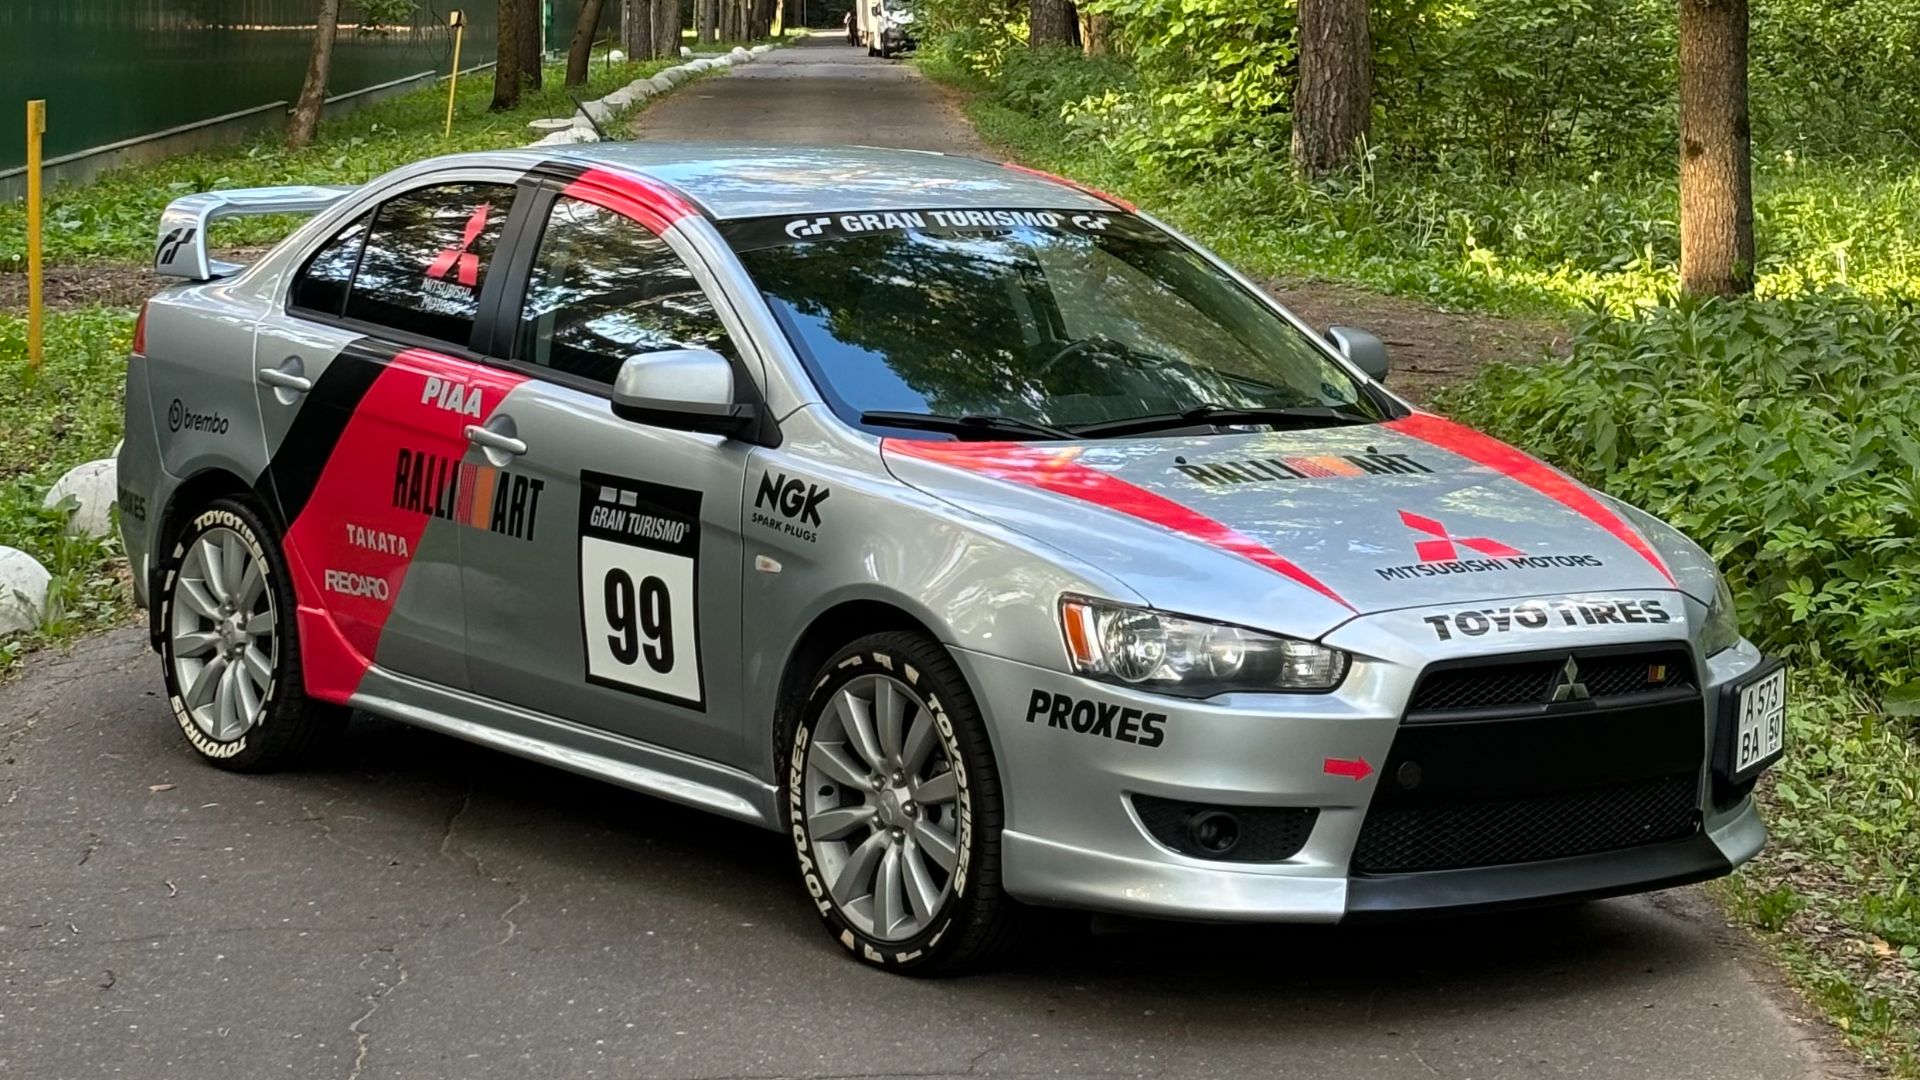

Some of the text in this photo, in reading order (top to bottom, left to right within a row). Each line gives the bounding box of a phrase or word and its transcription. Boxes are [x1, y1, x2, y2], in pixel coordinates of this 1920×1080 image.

[840, 211, 927, 232] GRAN
[421, 277, 472, 300] MITSUBISHI
[420, 376, 483, 418] PIAA
[184, 407, 229, 435] brembo
[754, 468, 830, 529] NGK
[590, 505, 626, 532] GRAN
[751, 512, 818, 543] SPARK PLUGS
[346, 523, 408, 558] TAKATA
[1374, 554, 1604, 581] MITSUBISHI MOTORS
[324, 569, 389, 601] RECARO
[604, 567, 675, 674] 99
[1026, 689, 1167, 748] PROXES
